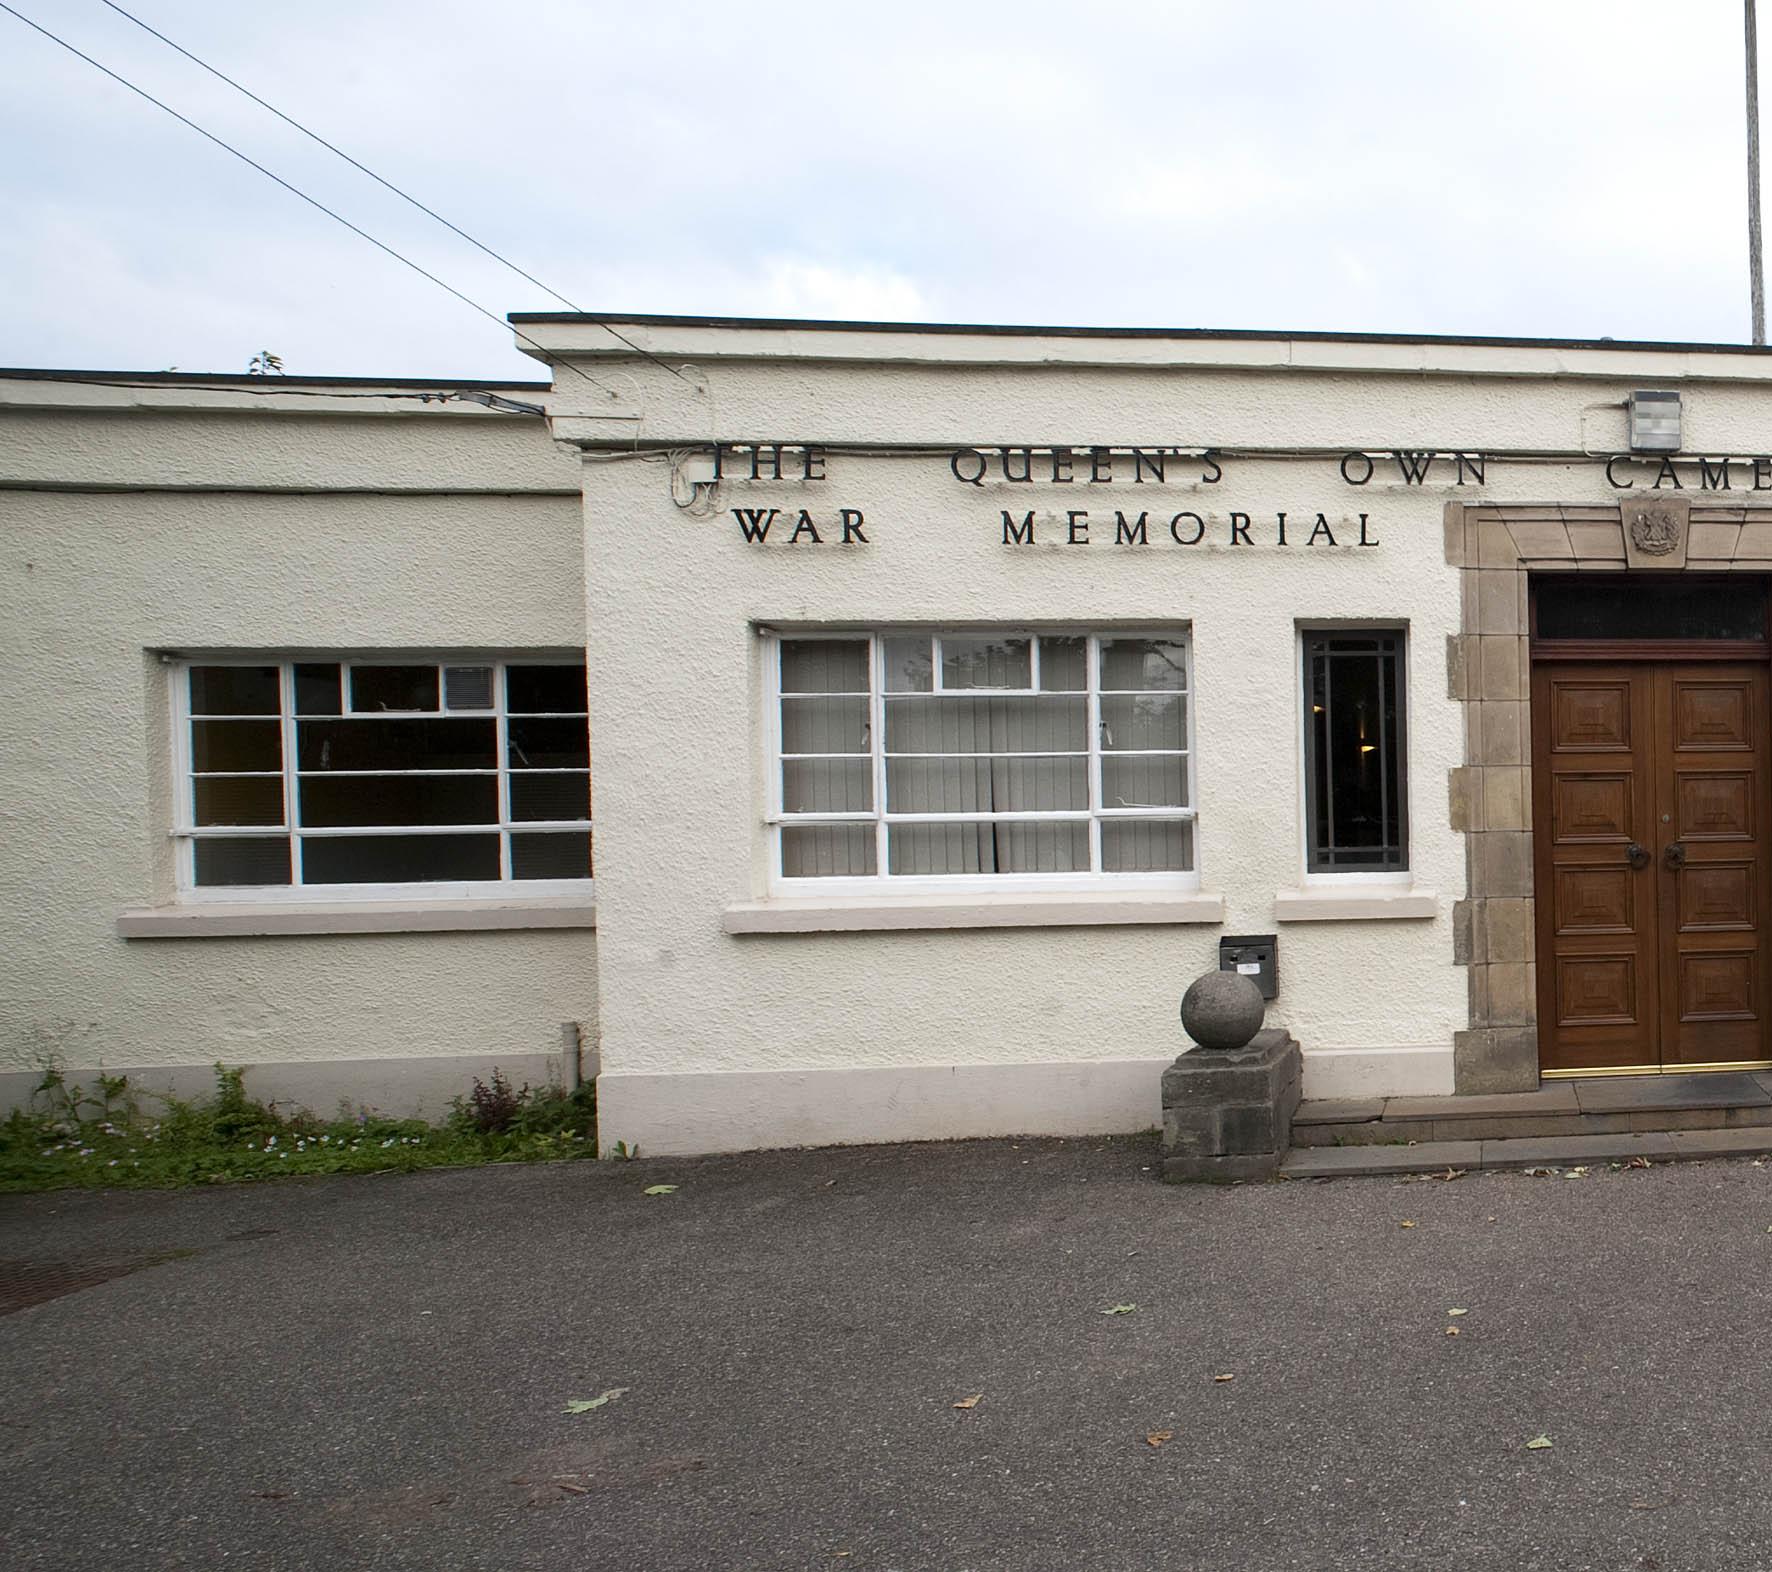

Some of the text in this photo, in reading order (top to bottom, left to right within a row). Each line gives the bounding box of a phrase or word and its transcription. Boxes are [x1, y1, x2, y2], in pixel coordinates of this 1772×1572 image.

[701, 445, 828, 481] THE
[950, 448, 1222, 487] QUEEN'S
[1340, 451, 1487, 486] OWN
[731, 508, 869, 544] WAR
[1001, 510, 1380, 547] MEMORIAL
